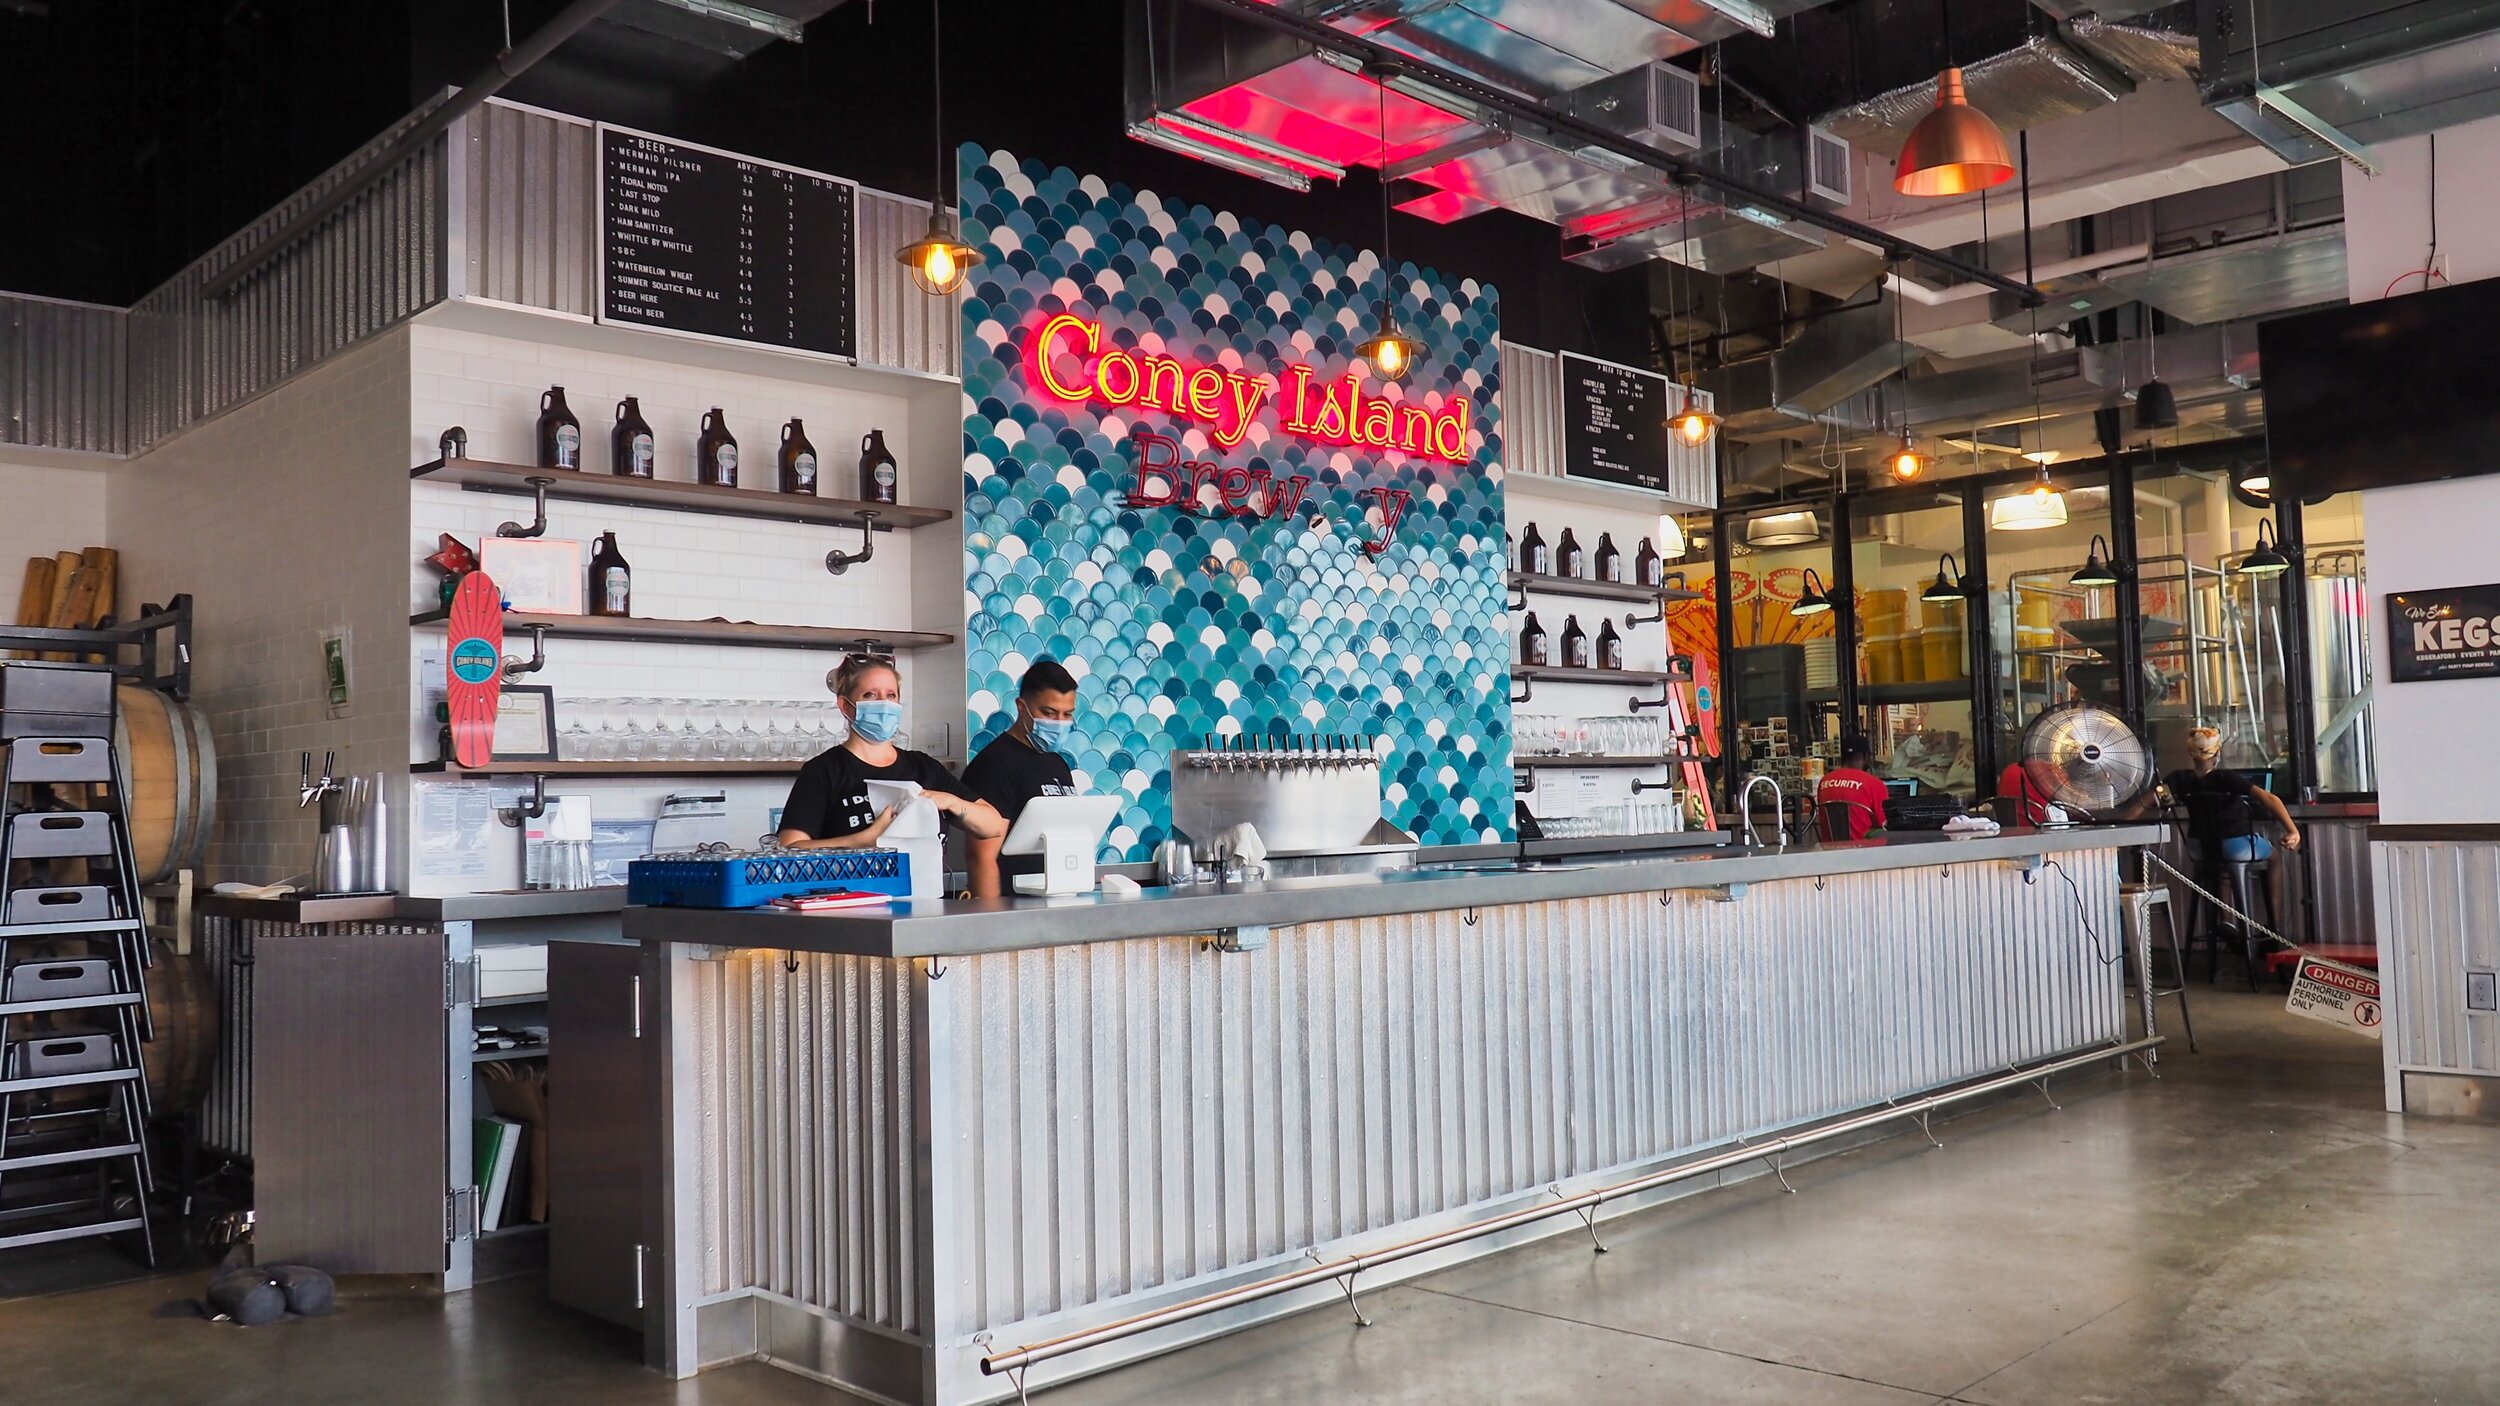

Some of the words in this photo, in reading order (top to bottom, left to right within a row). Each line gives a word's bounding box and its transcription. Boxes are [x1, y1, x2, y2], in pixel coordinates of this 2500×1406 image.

[638, 139, 666, 154] BEER
[619, 147, 659, 163] MERMAID
[664, 157, 702, 172] PILSNER
[743, 175, 753, 184] 5.2
[620, 162, 657, 176] MERMAN
[666, 172, 680, 181] IPA
[742, 189, 752, 197] 5.8
[621, 176, 645, 188] FLORAL
[647, 182, 668, 193] NOTES
[841, 185, 847, 193] 16
[619, 203, 639, 213] DARK
[642, 207, 660, 217] MILD
[843, 247, 847, 255] 7
[620, 188, 638, 199] LAST
[642, 193, 661, 203] STOP
[741, 214, 752, 223] 7.1
[843, 234, 847, 242] 7
[617, 218, 633, 227] HAM
[635, 220, 674, 235] SANITIZER
[740, 241, 752, 250] 5.5
[617, 232, 649, 244] WHITTLE
[662, 240, 693, 253] WHITTLE
[739, 255, 752, 264] 5.0
[617, 246, 636, 256] SBC
[618, 261, 666, 276] WATERMELON
[670, 270, 693, 281] WHEAT
[739, 283, 752, 291] 4.6
[789, 291, 793, 299] 3
[841, 300, 845, 308] 7
[618, 275, 648, 287] SUMMER
[652, 281, 684, 293] SOLSTICE
[687, 288, 702, 297] PALE
[706, 291, 720, 300] ALE
[739, 297, 752, 305] 5.5
[840, 315, 844, 323] 7
[618, 290, 636, 300] BEER
[640, 294, 658, 303] HERE
[740, 312, 752, 320] 4.5
[618, 304, 642, 315] BEACH
[646, 309, 664, 319] BEER
[1038, 314, 1269, 447] Coney
[1285, 364, 1470, 462] Island
[1127, 431, 1311, 521] Brew
[2413, 615, 2500, 651] KEGS
[1820, 780, 1862, 790] SECURITY
[2296, 979, 2351, 1001] AUTHORIZED
[2314, 968, 2376, 994] DANGER
[2291, 998, 2314, 1011] ONLY
[2294, 989, 2344, 1010] PERSONNEL
